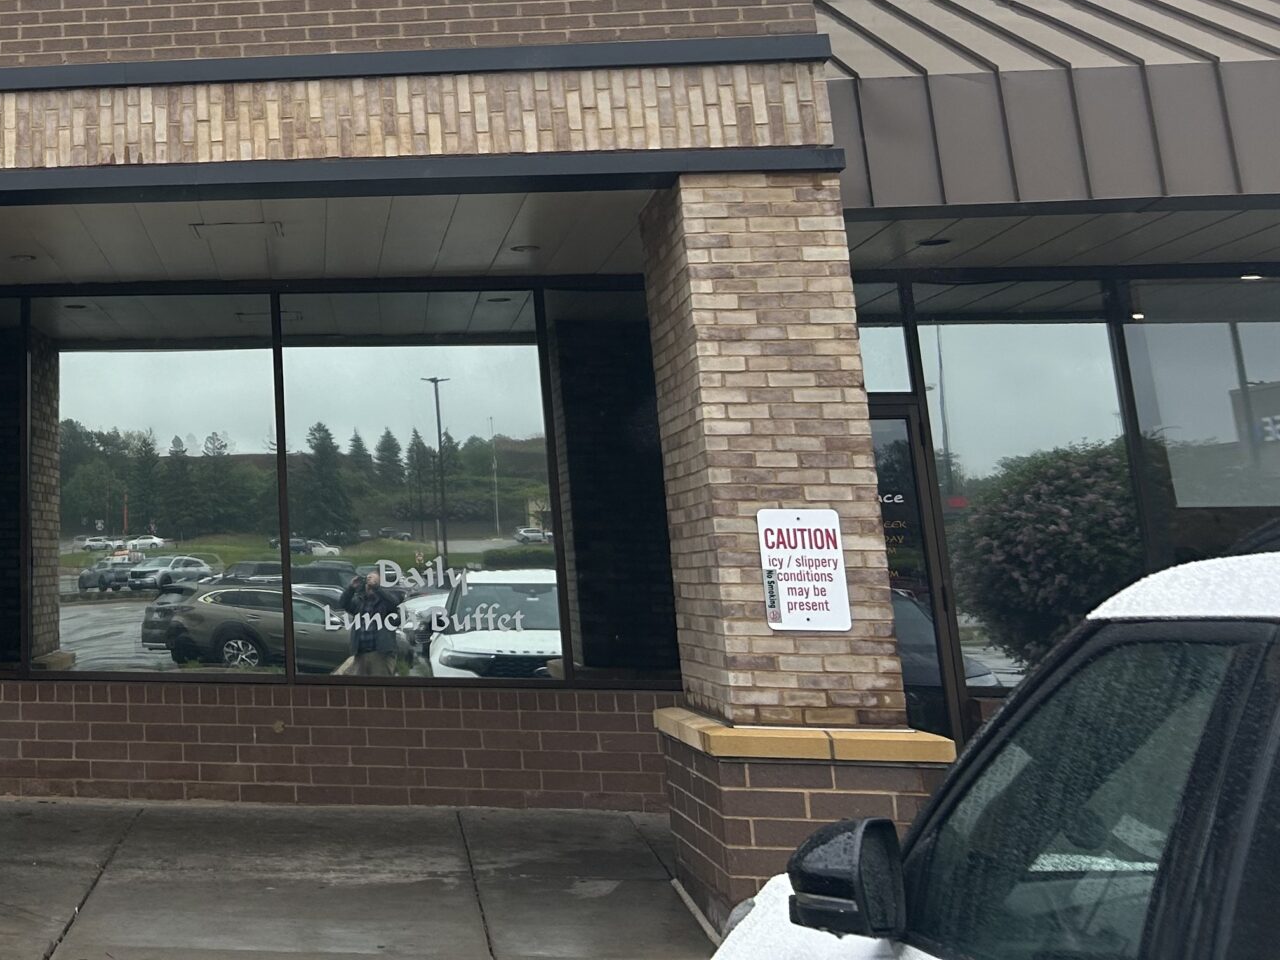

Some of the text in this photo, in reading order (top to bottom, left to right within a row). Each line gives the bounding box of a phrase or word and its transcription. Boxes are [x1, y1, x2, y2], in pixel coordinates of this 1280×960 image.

[763, 527, 839, 550] CAUTION
[768, 555, 784, 570] icy
[795, 555, 838, 571] slippery
[375, 555, 469, 596] Daily
[776, 570, 834, 582] conditions
[766, 569, 777, 609] No Smoking
[787, 584, 827, 599] may be
[787, 599, 831, 613] present
[324, 602, 525, 632] Lunch Buffet
